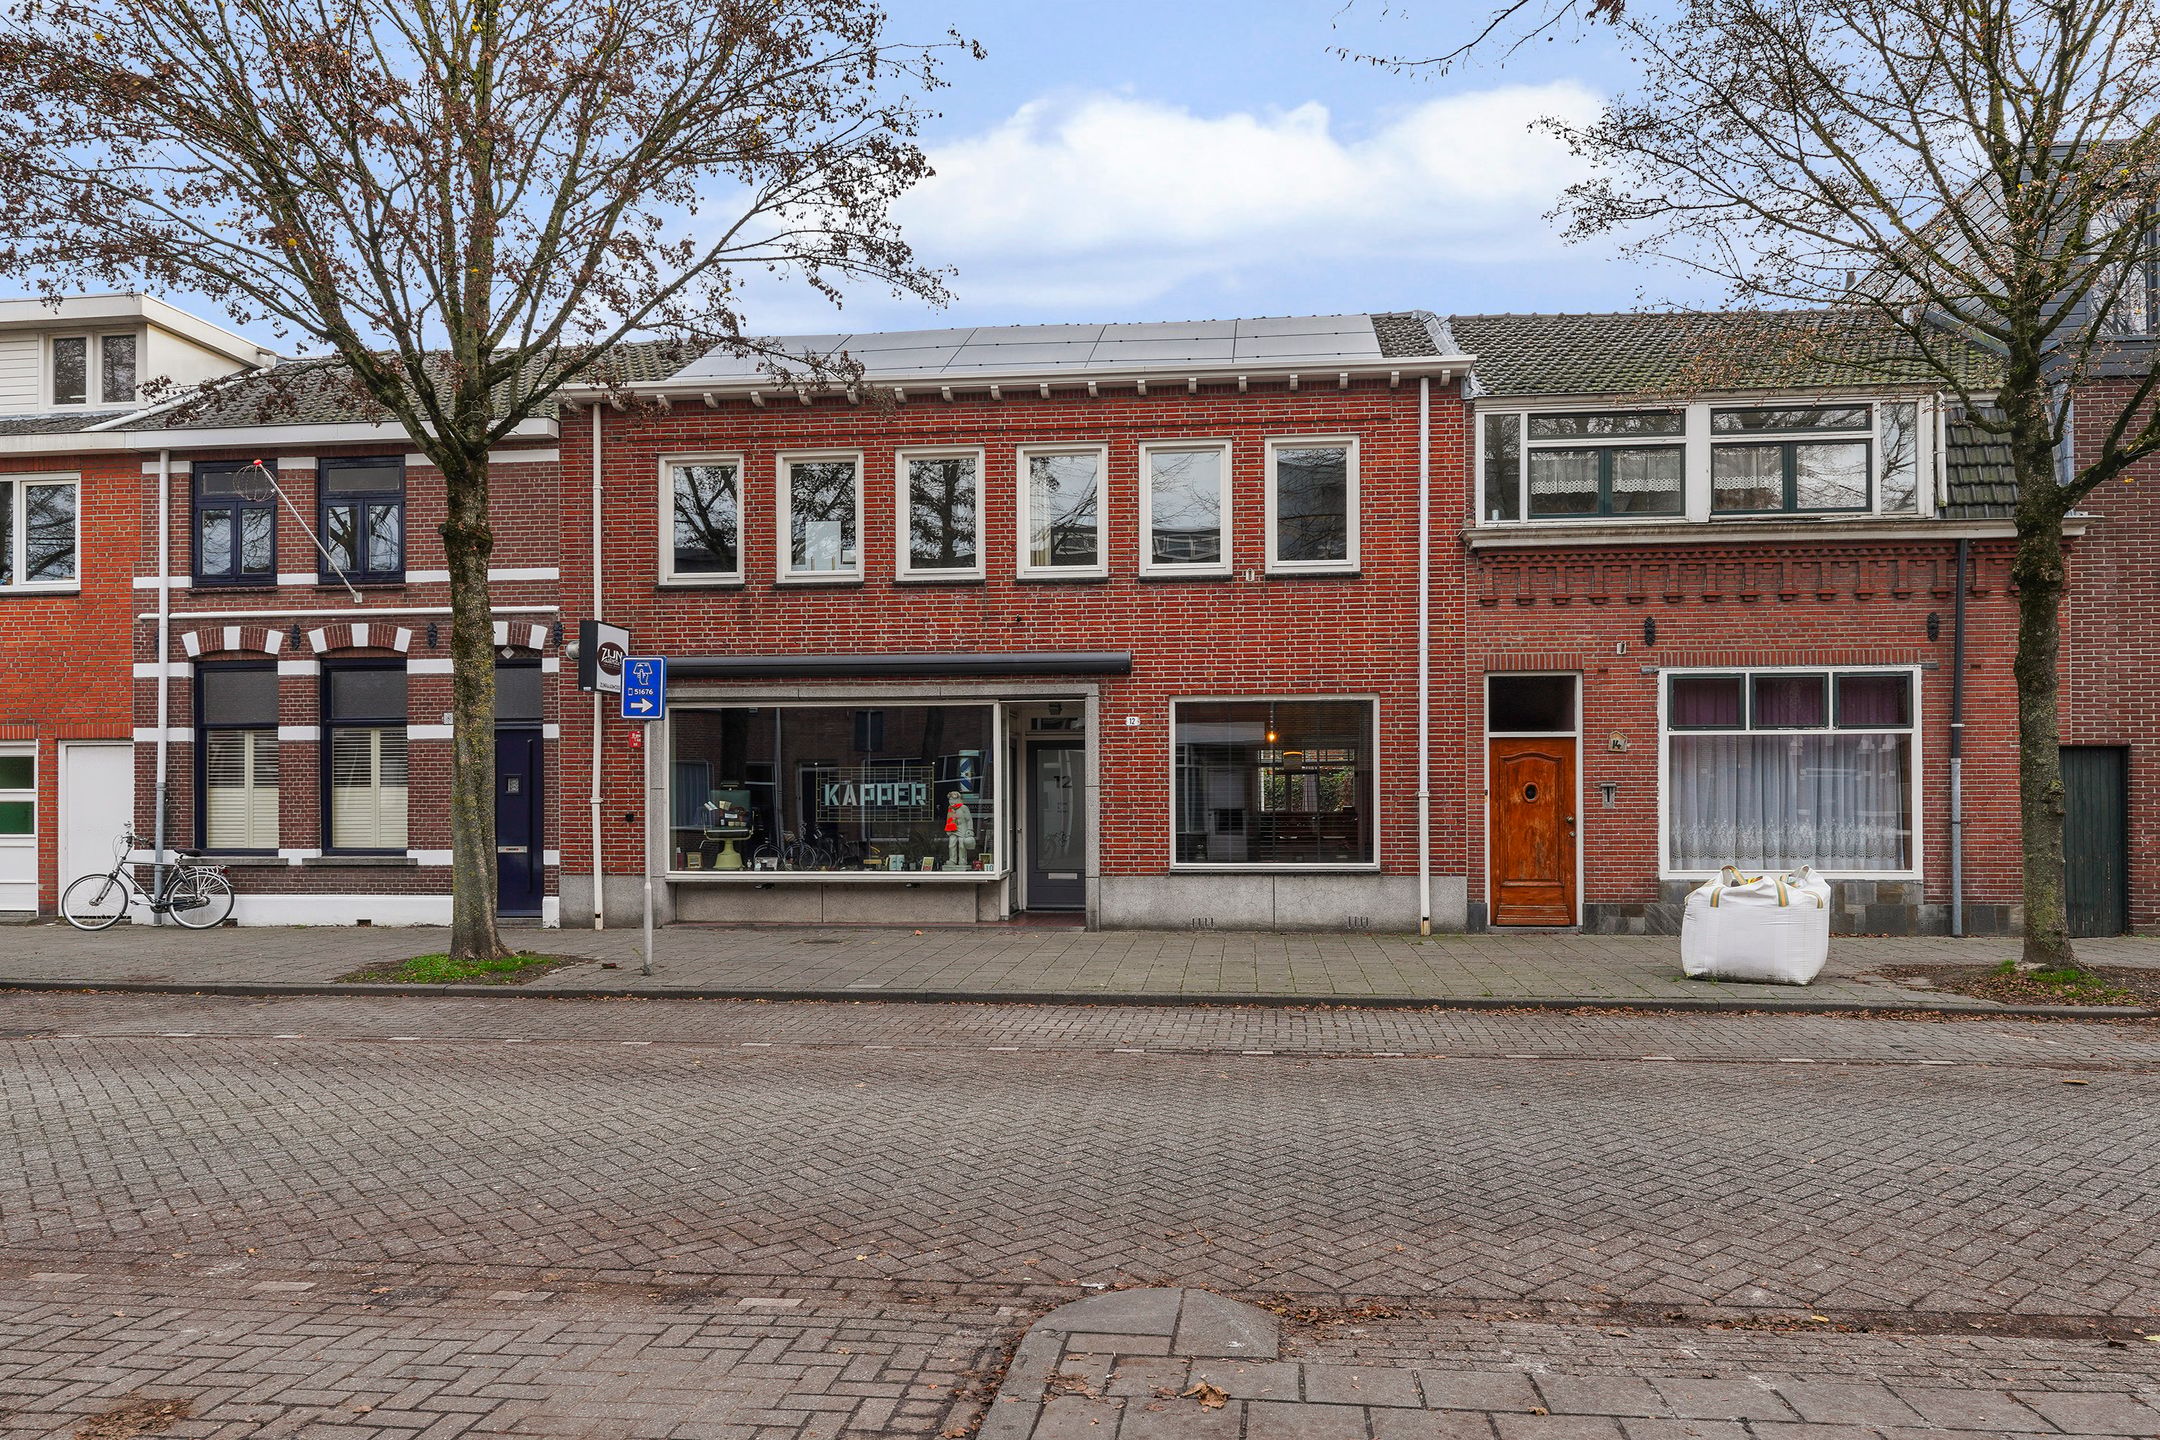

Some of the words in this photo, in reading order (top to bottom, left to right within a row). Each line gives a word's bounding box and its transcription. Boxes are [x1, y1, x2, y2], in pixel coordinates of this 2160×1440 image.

[1129, 717, 1136, 725] 12
[1612, 739, 1622, 749] 14
[1053, 775, 1072, 789] 12
[824, 783, 926, 806] KAPPER
